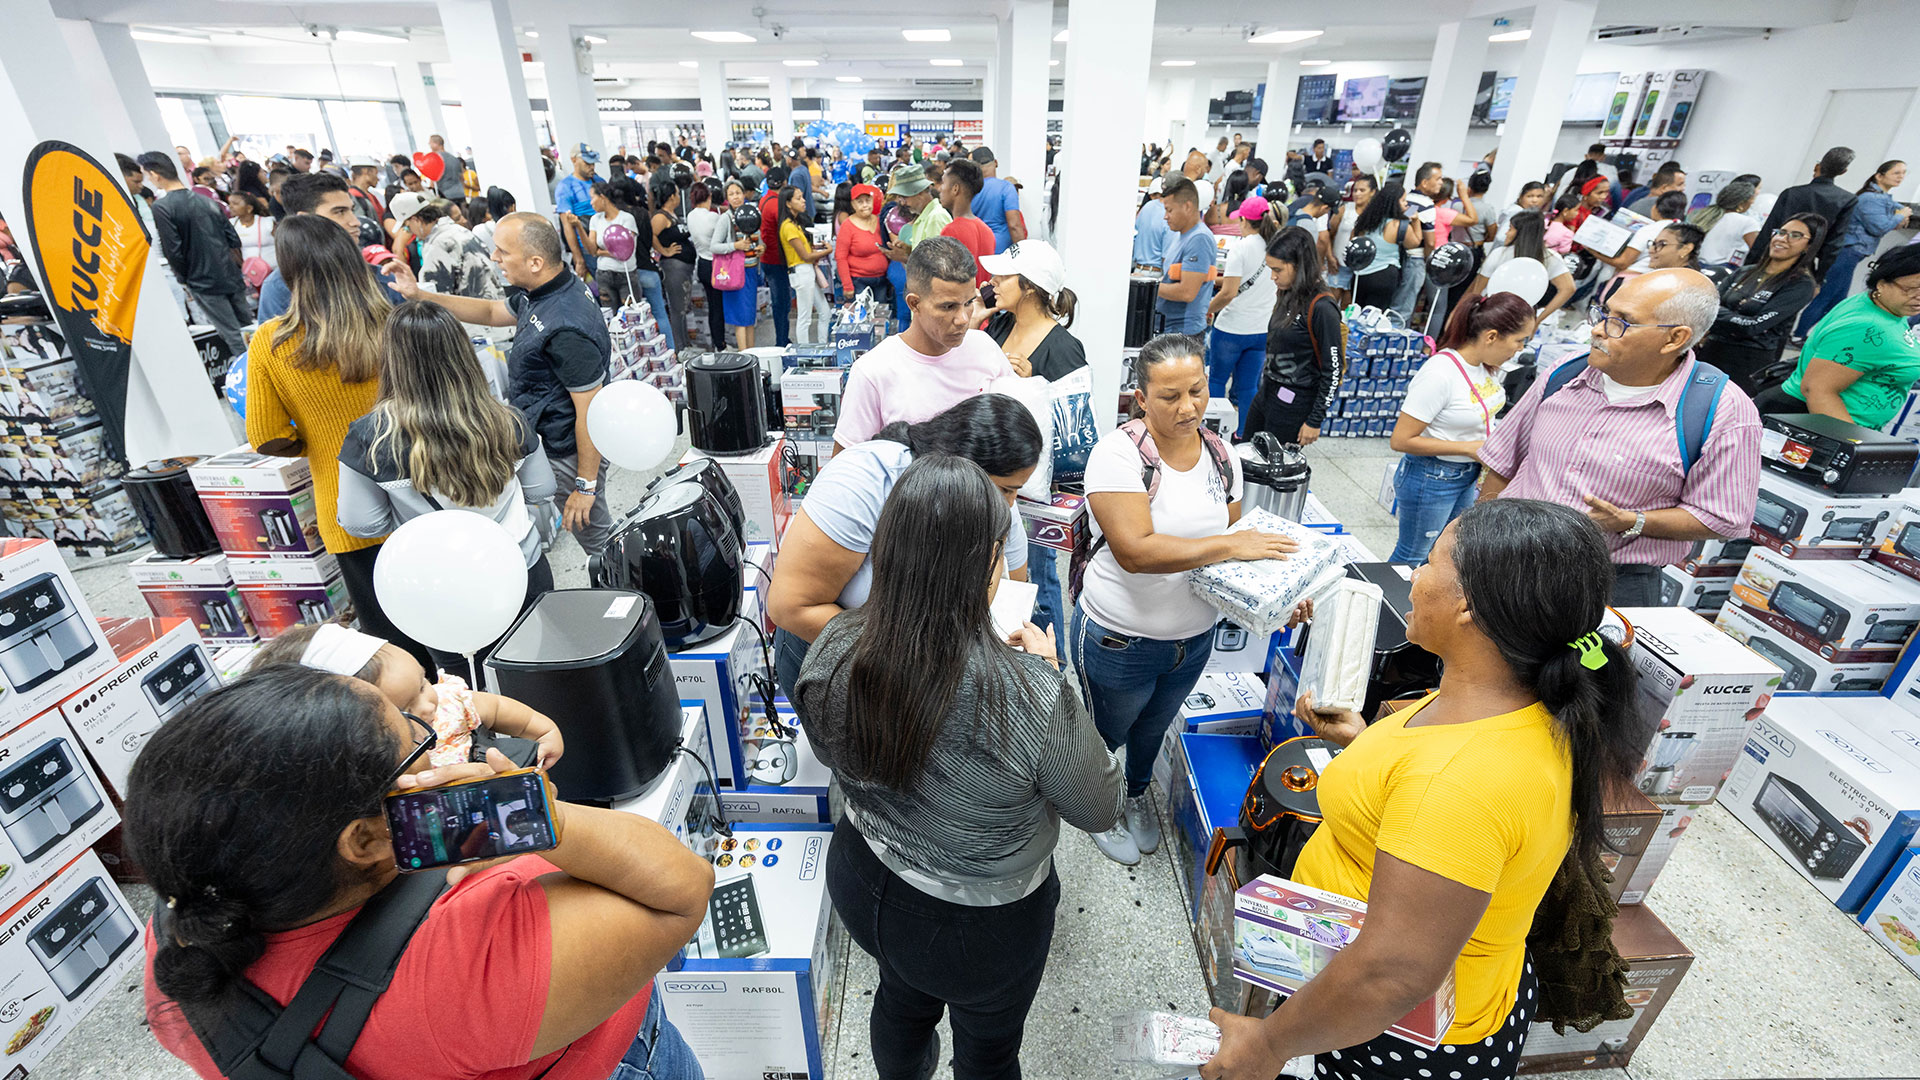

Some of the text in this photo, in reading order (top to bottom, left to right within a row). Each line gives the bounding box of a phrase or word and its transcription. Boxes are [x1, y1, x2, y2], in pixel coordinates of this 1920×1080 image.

[71, 175, 103, 317] KUCCE
[838, 338, 860, 350] Oster
[1764, 558, 1798, 578] PREMIER
[1737, 612, 1768, 634] PREMIER
[97, 650, 160, 697] PREMIER
[1703, 685, 1754, 695] KUCCE
[83, 702, 117, 728] OIL-LESS
[1824, 732, 1879, 771] ROYAL
[1829, 771, 1893, 821] ELECTRIC OVEN
[772, 807, 807, 815] RAF70L
[801, 839, 821, 878] ROYAL
[1240, 897, 1271, 911] UNIVERSAL
[1252, 906, 1270, 915] ROYAL
[668, 983, 785, 994] ROYAL RAF80L
[1, 1001, 20, 1017] 6.0L
